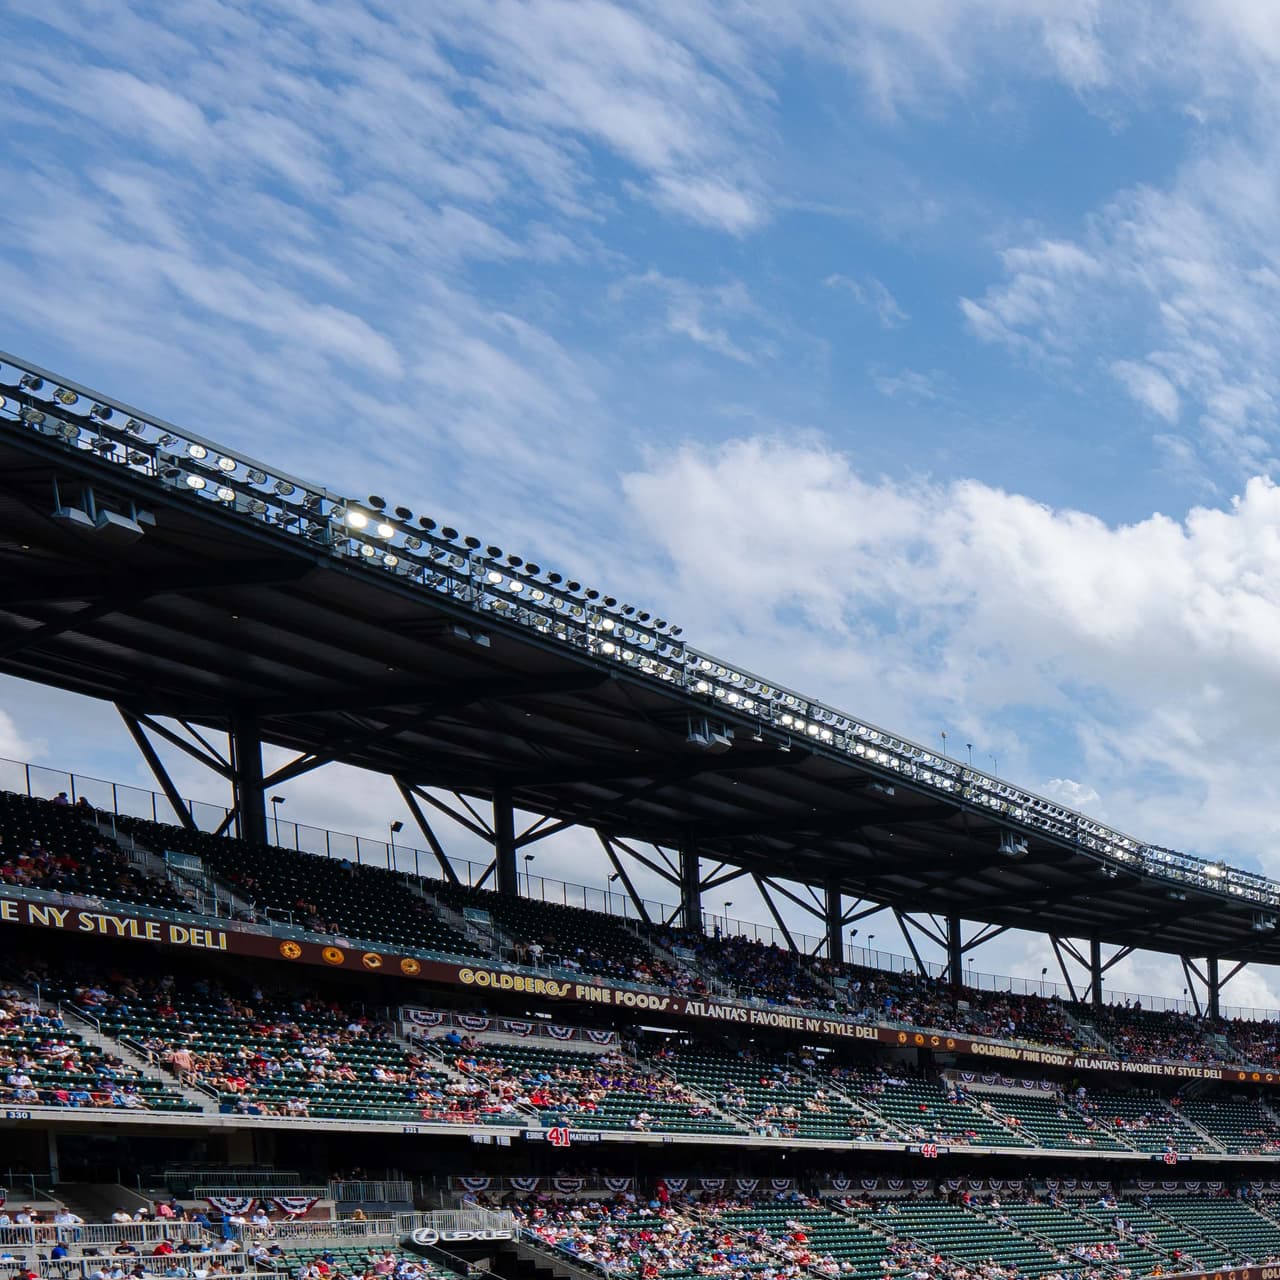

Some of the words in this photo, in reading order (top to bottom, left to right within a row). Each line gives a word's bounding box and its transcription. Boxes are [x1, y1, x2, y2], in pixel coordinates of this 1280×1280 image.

[29, 904, 69, 927] NY
[79, 912, 161, 941] STYLE
[170, 925, 226, 950] DELI
[459, 968, 571, 997] GOLDBERGS
[576, 985, 610, 1003] FINE
[615, 991, 670, 1010] FOODS
[685, 1001, 747, 1022] ATLANTA'S
[750, 1010, 803, 1030] FAVORITE
[806, 1019, 821, 1032] NY
[823, 1022, 853, 1036] STYLE
[856, 1027, 878, 1040] DELI
[526, 1132, 544, 1140] EDDIE
[548, 1128, 570, 1147] 41
[442, 1231, 511, 1240] LEXUS
